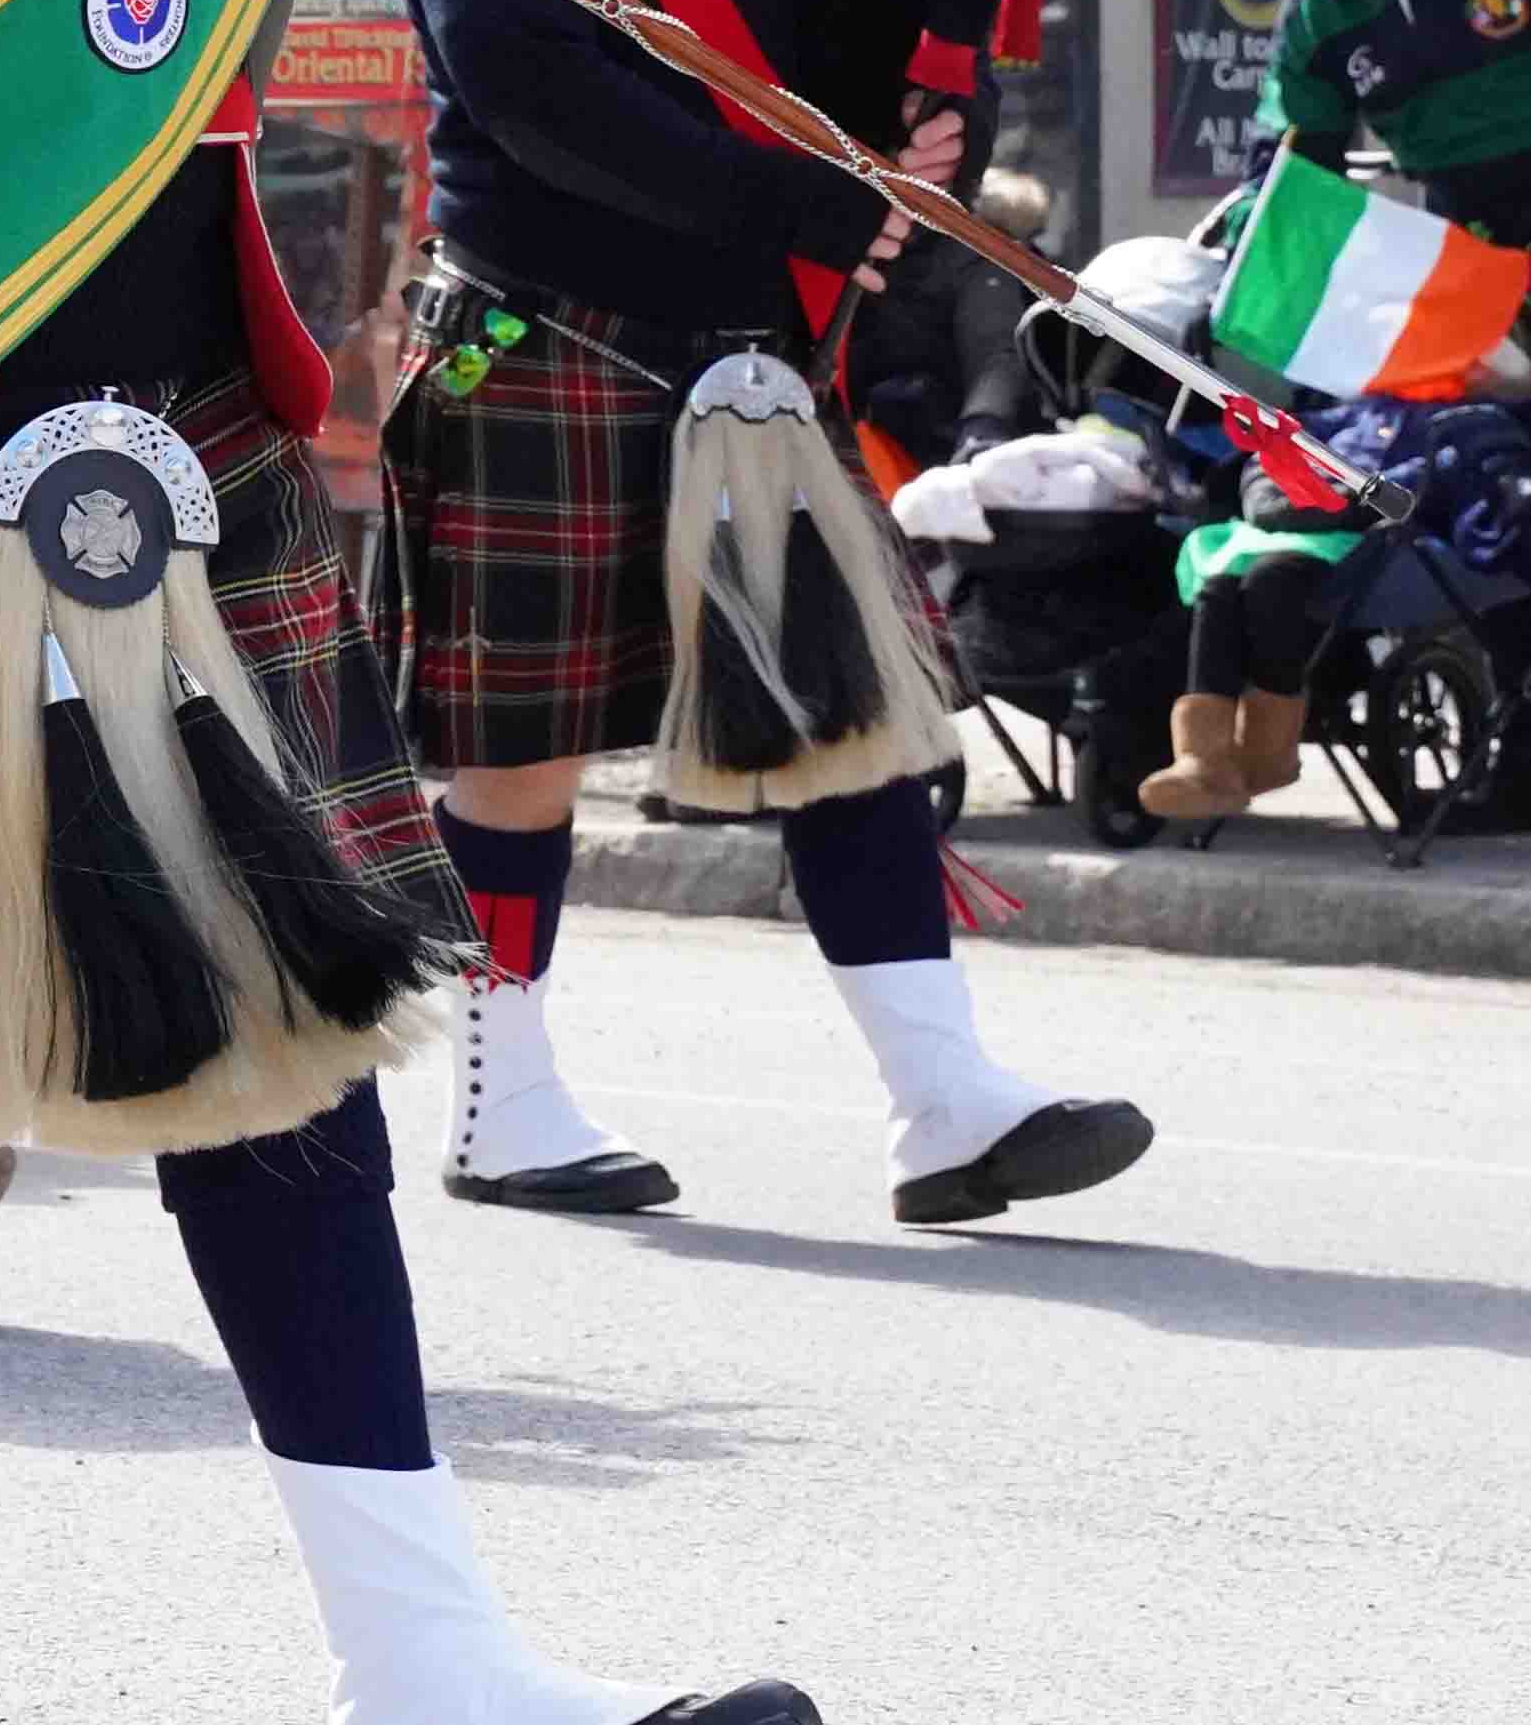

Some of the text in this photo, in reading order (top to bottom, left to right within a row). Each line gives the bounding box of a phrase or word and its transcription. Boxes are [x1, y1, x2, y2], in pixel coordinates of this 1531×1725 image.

[1173, 30, 1236, 61] Wall
[272, 50, 394, 84] Oriental
[1195, 116, 1236, 147] All
